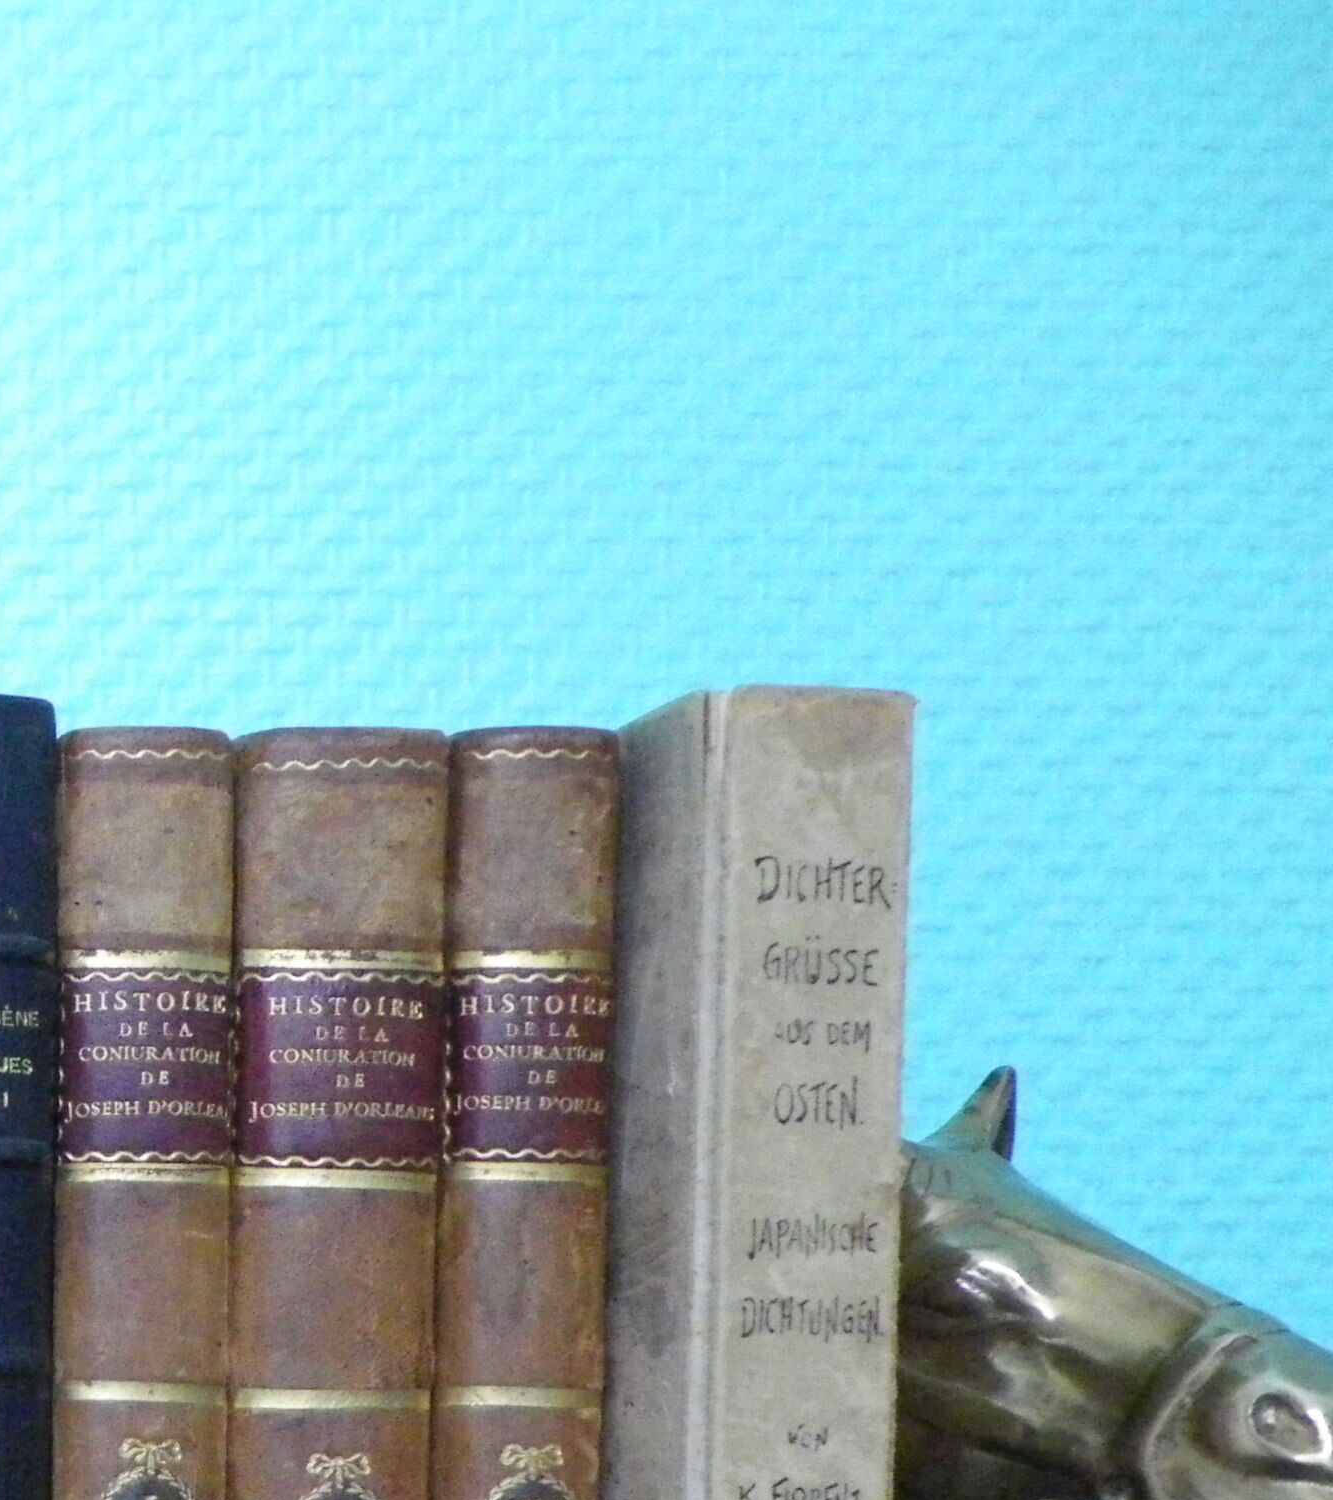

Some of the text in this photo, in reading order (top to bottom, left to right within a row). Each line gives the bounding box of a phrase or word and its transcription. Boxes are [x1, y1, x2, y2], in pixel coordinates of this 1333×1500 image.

[763, 935, 880, 986] GRÜSSE
[73, 989, 227, 1014] HISTOIRE
[269, 995, 424, 1020] HISTOIRE
[460, 993, 610, 1017] HISTOIRE
[119, 1021, 193, 1038] DE LA
[315, 1025, 389, 1042] DE LA
[505, 1021, 579, 1038] DE LA
[827, 1020, 872, 1053] DEM
[140, 1070, 170, 1086] DE
[335, 1073, 365, 1088] DE
[528, 1069, 558, 1085] DE
[64, 1100, 140, 1123] JOSEPH
[248, 1101, 327, 1123] JOSEPH
[454, 1094, 531, 1115] JOSEPH
[774, 1075, 865, 1129] OSTEN.
